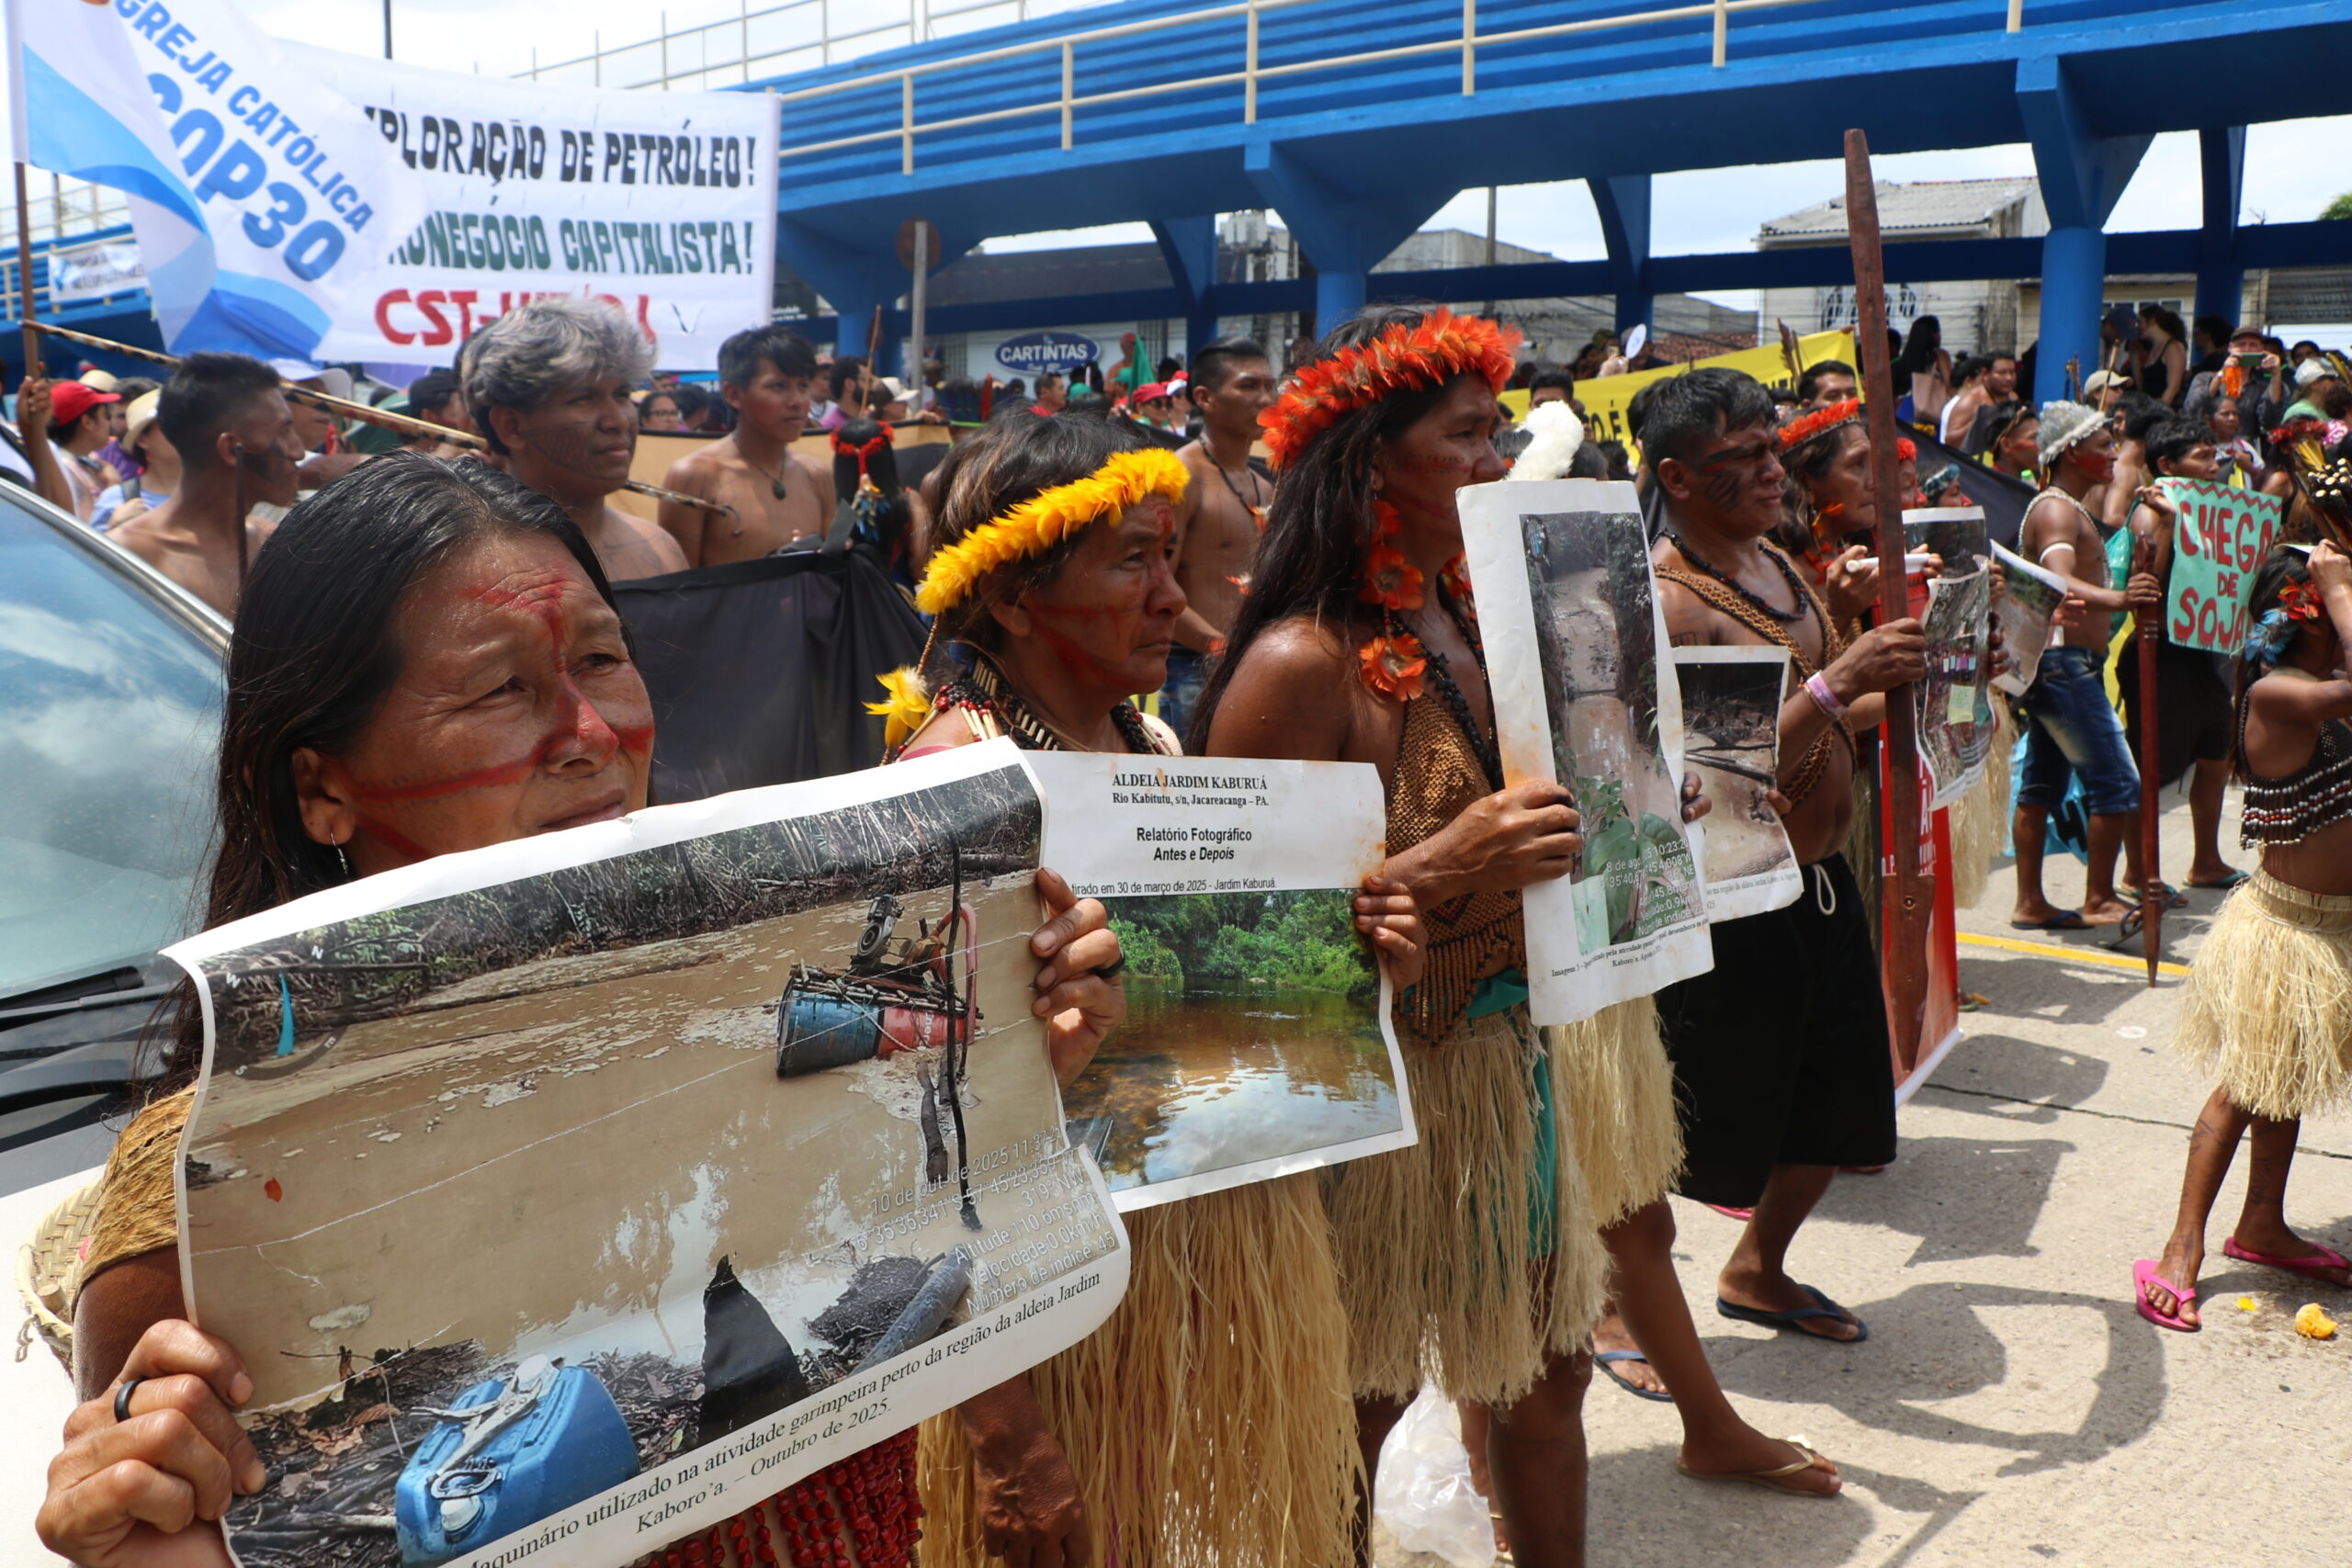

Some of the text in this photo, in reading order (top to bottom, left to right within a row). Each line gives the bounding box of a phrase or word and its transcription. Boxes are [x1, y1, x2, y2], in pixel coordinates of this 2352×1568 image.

[227, 85, 373, 232] CATÓLICA
[364, 106, 756, 188] PLORAÇÃO DE PETRÓLEO!
[559, 219, 752, 275] CAPITALISTA!
[1001, 344, 1089, 362] CARTINTAS
[2179, 501, 2273, 573] CHEGA
[2217, 571, 2239, 598] DE
[1112, 773, 1268, 790] ALDEIA JARDIM KABURUÁ
[1112, 793, 1128, 803] Rio
[1175, 794, 1190, 806] s/n,
[1191, 795, 1247, 808] Jacareacanga
[1255, 795, 1269, 806] PA.
[1136, 827, 1252, 844] Relatório Fotográfico
[1153, 847, 1235, 863] Antes e Depois
[1071, 882, 1099, 895] tirado
[1101, 885, 1115, 894] em
[1117, 882, 1128, 894] 30
[1130, 882, 1142, 893] de
[1144, 883, 1170, 897] março
[1173, 880, 1184, 892] de
[1186, 879, 1206, 891] 2025
[1214, 878, 1240, 890] Jardim
[1243, 877, 1277, 889] Kaburuá.
[871, 1193, 890, 1215] 10
[895, 1187, 913, 1207] de
[951, 1165, 969, 1184] de
[972, 1146, 1009, 1176] 2025
[1057, 1168, 1084, 1192] NW
[1031, 1265, 1048, 1285] de
[1098, 1230, 1115, 1250] 45
[585, 1475, 671, 1526] utilizado
[677, 1464, 698, 1486] na
[705, 1423, 786, 1472] atividade
[789, 1380, 877, 1435] garimpeira
[881, 1359, 921, 1393] perto
[924, 1347, 942, 1366] da
[946, 1324, 990, 1354] região
[995, 1314, 1012, 1333] da
[1014, 1294, 1054, 1324] aldeia
[1057, 1271, 1101, 1303] Jardim
[751, 1435, 818, 1476] Outubro
[822, 1419, 842, 1439] de
[847, 1397, 891, 1430] 2025.
